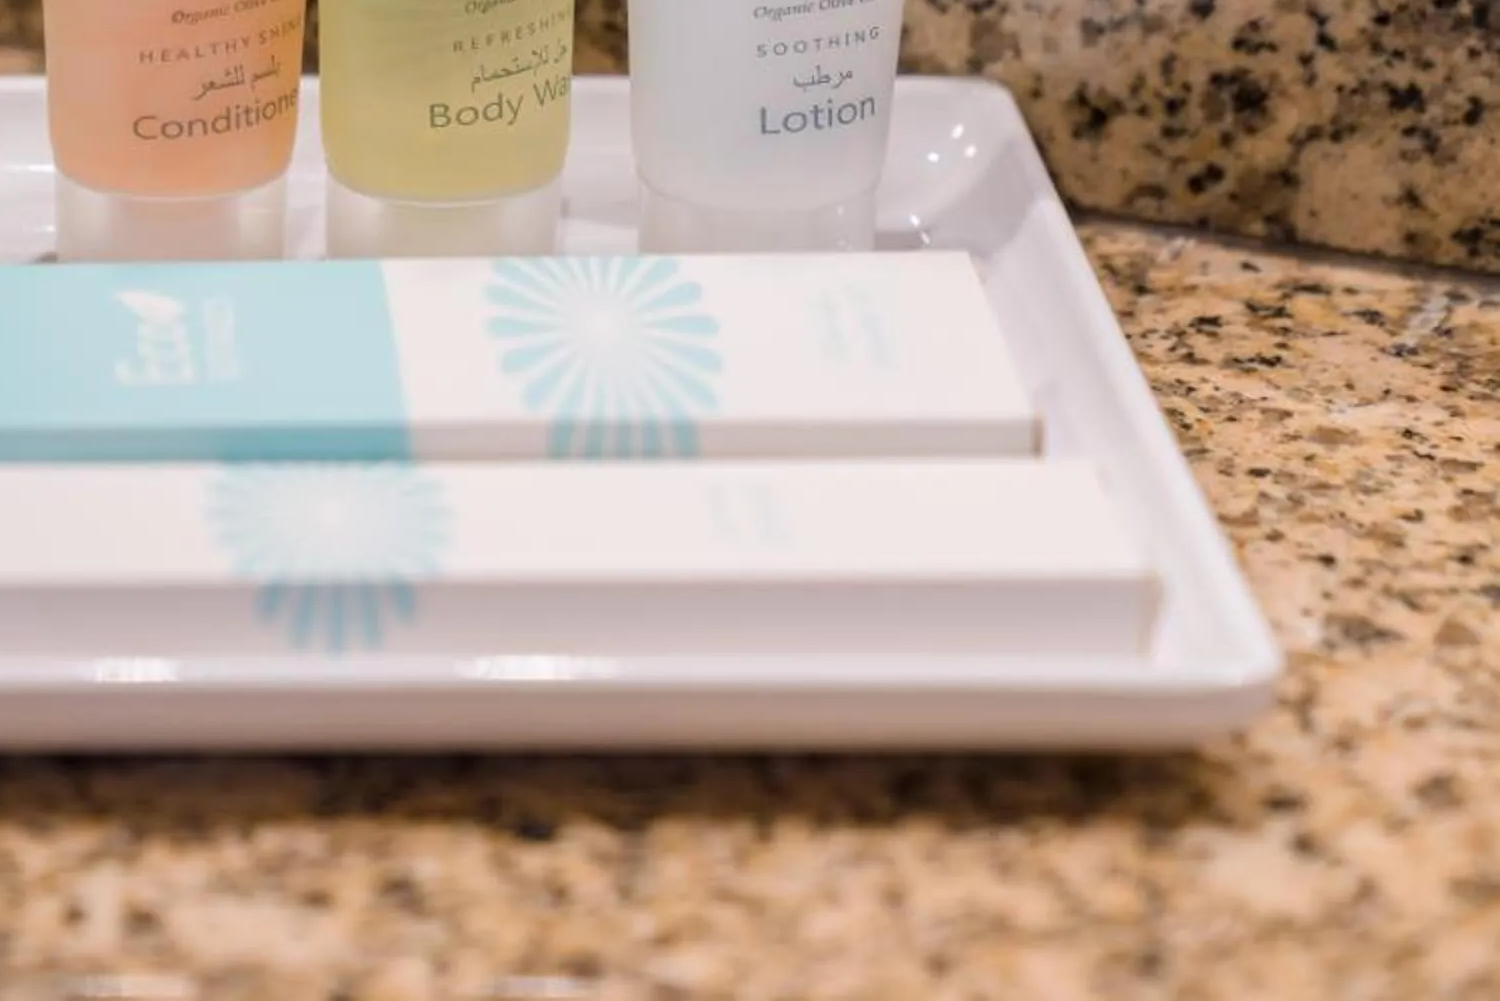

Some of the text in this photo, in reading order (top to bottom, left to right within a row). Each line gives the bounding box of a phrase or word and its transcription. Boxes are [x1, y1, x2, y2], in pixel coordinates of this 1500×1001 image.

[139, 15, 300, 64] HEALTHY SHIN
[453, 11, 567, 52] REFRESHIN
[756, 26, 880, 58] SOOTHING
[793, 64, 853, 93] مرطب
[133, 87, 298, 140] Conditione
[429, 91, 525, 129] Body
[760, 95, 877, 136] Lotion
